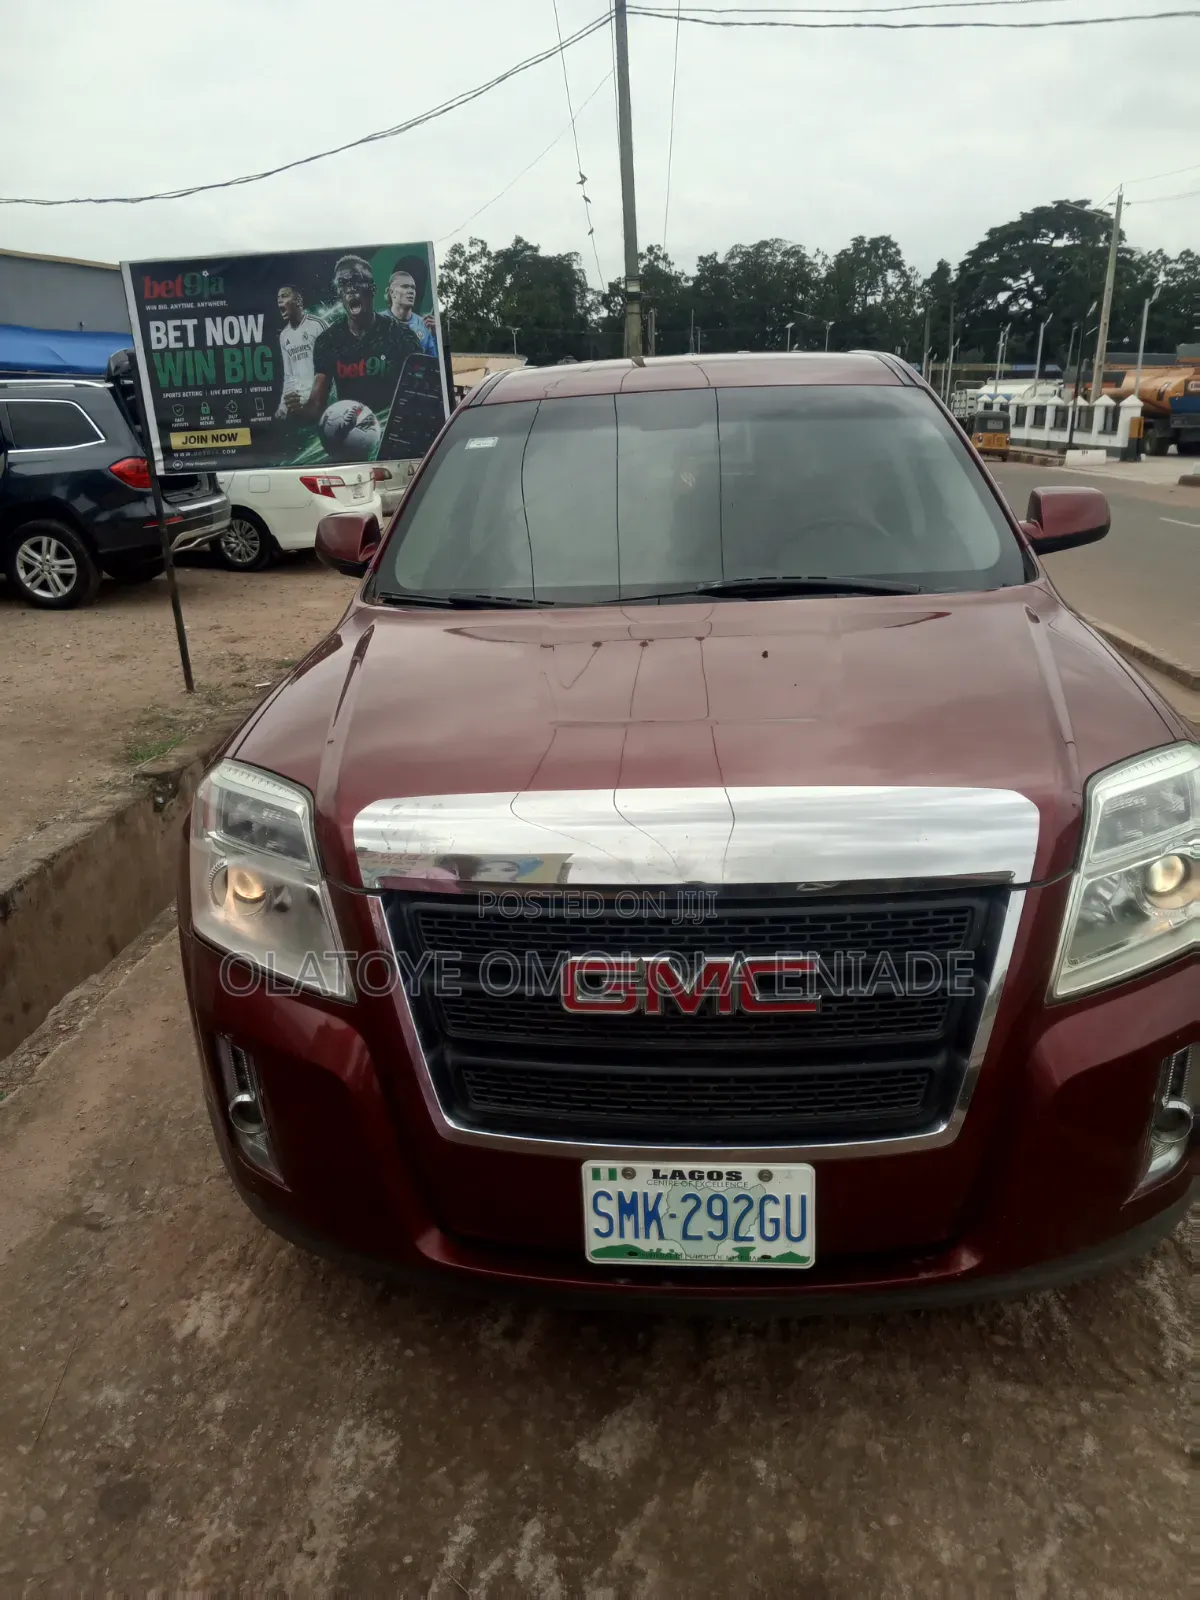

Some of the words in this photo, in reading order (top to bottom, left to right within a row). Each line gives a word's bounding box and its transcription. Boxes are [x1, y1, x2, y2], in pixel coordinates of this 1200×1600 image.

[143, 271, 225, 299] bet9ja
[197, 300, 228, 308] ANYWHERE.
[149, 318, 198, 350] BET
[205, 313, 264, 346] NOW
[152, 349, 217, 388] WIN
[223, 345, 274, 384] BIG
[337, 356, 389, 379] bet9j
[181, 434, 208, 445] JOIN
[211, 432, 239, 443] NOW
[561, 955, 821, 1016] GMC
[651, 1168, 743, 1182] LAGOS
[696, 1181, 749, 1189] EXCELLENCE
[592, 1190, 807, 1243] SMK-292GU
